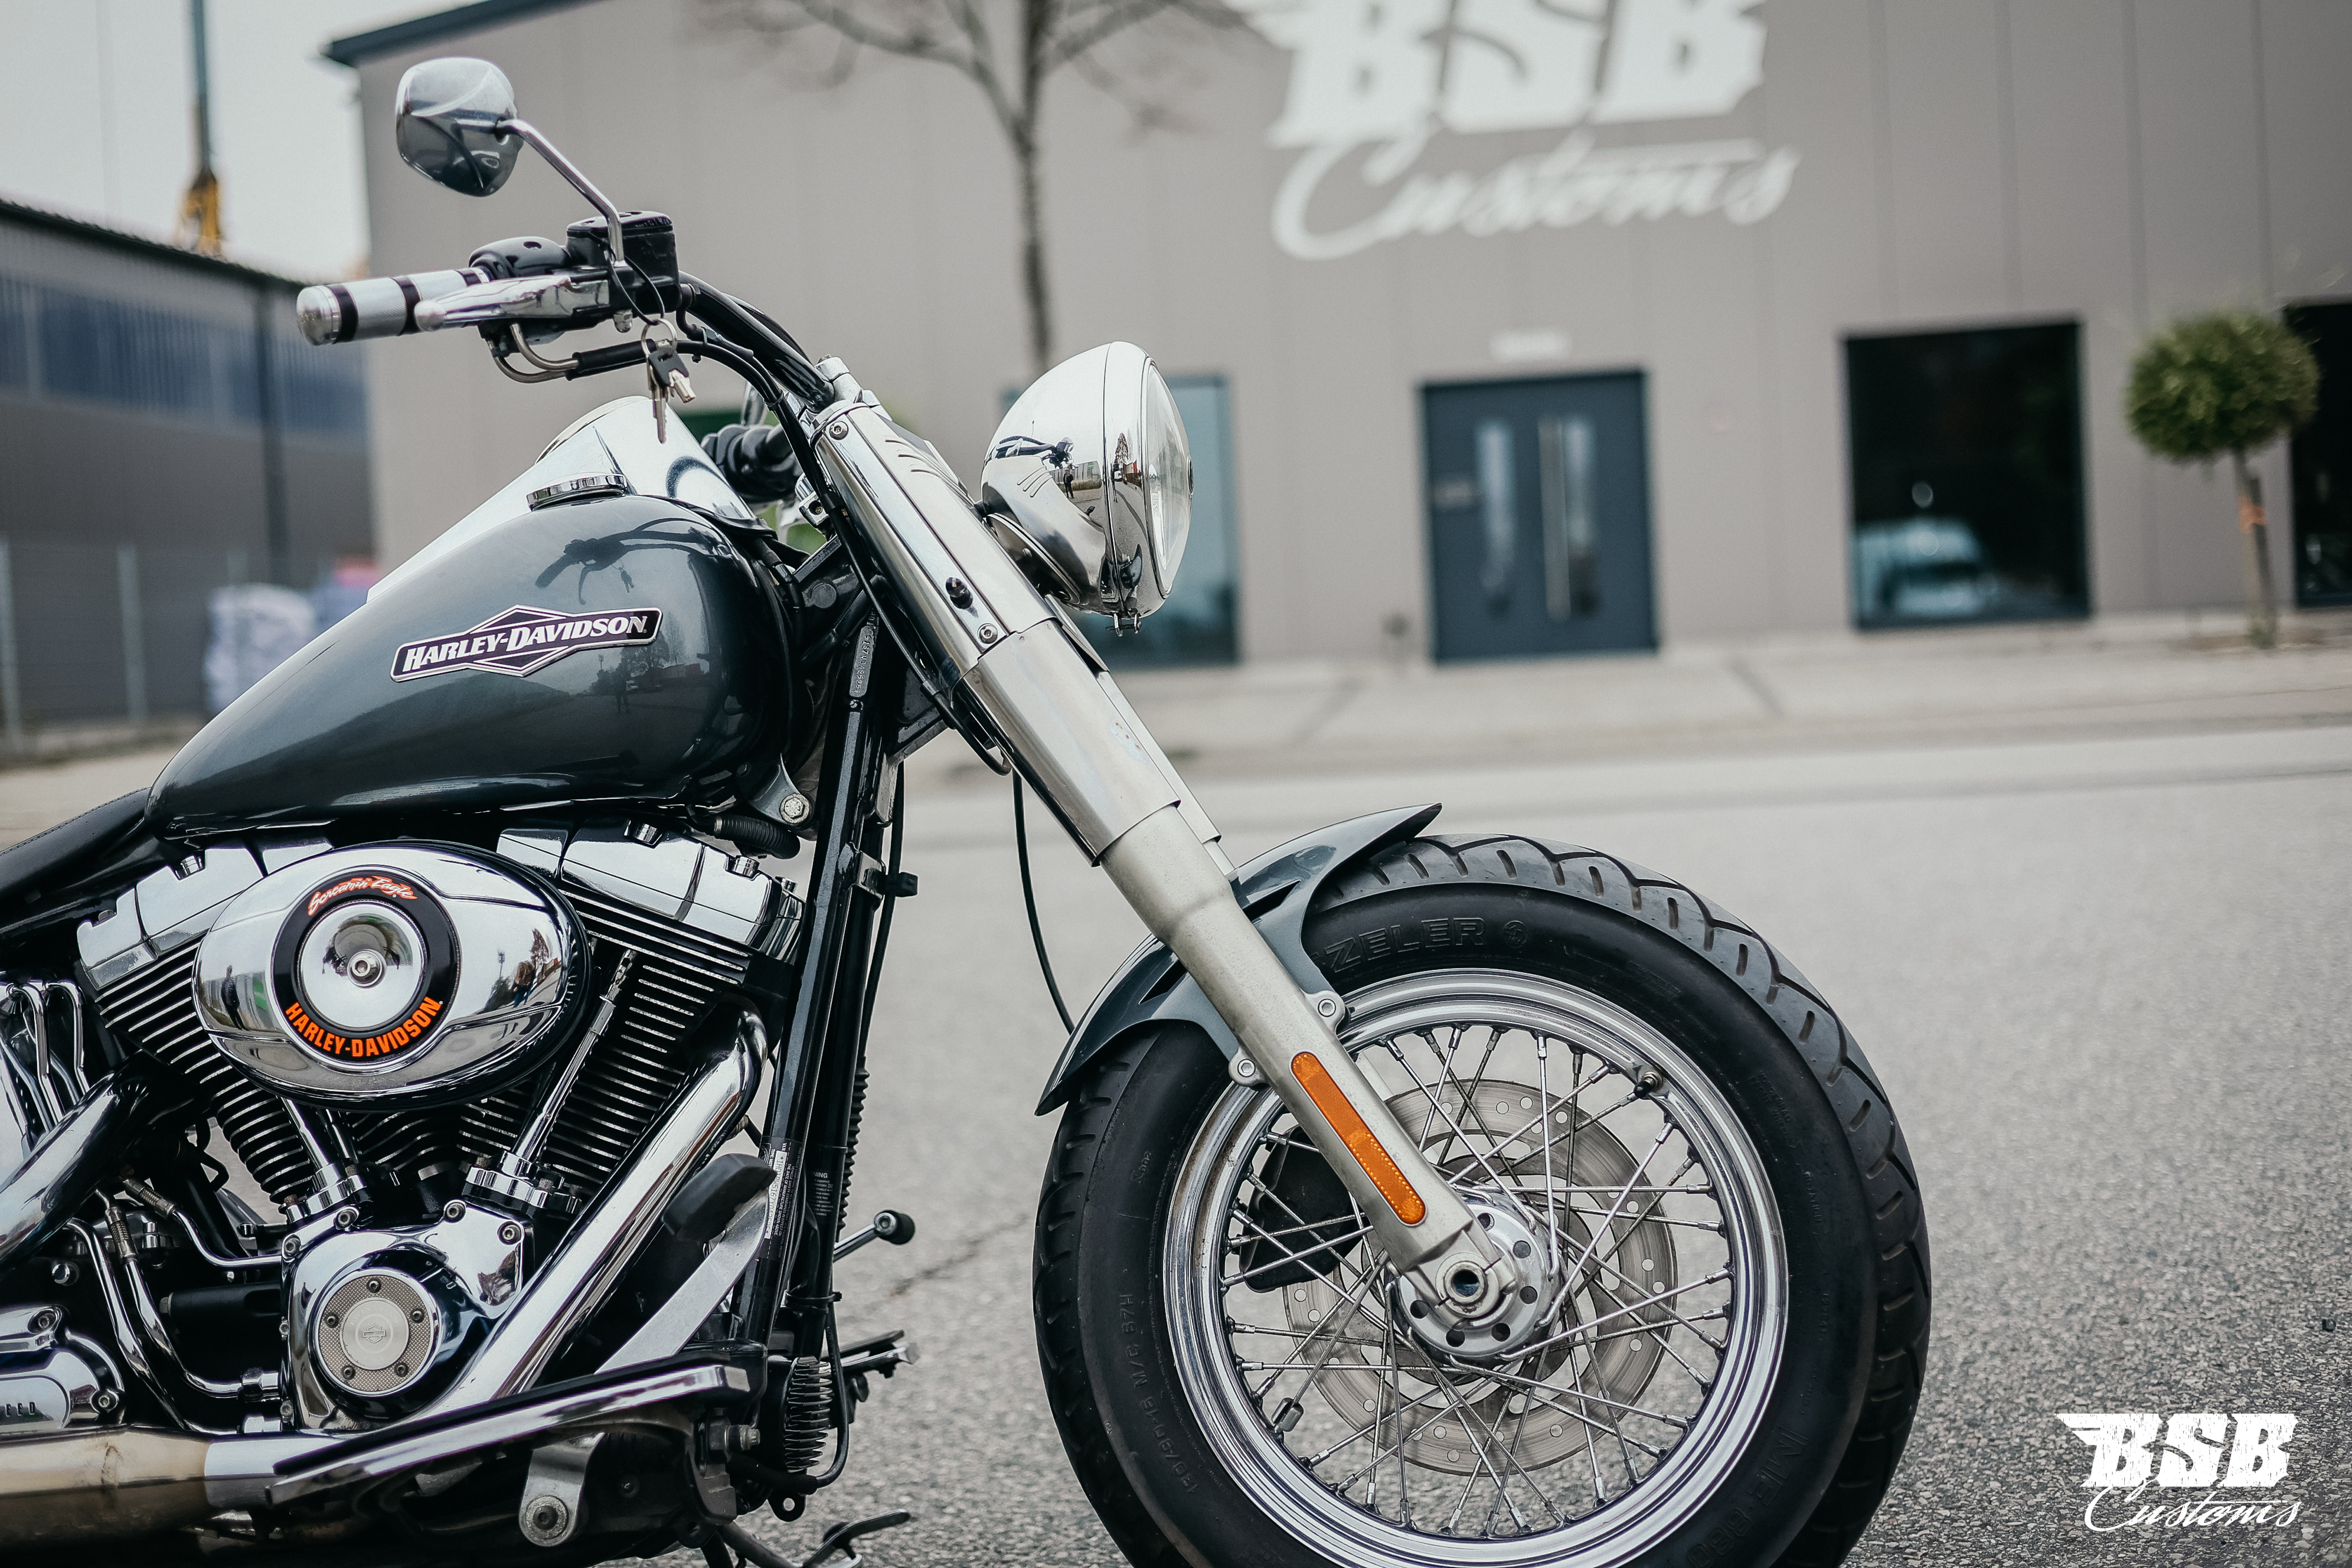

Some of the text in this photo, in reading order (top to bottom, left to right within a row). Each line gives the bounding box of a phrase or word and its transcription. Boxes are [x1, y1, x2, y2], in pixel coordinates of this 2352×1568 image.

[1246, 0, 1768, 148] BSB
[1271, 131, 1801, 260] Customs
[403, 616, 648, 672] HARLEY-DAVIDSON
[372, 876, 417, 899] Eagle
[1309, 917, 1486, 973] ZELER
[286, 997, 443, 1057] HARLEY-DAVIDSON
[779, 1184, 787, 1210] MANUFACTURE
